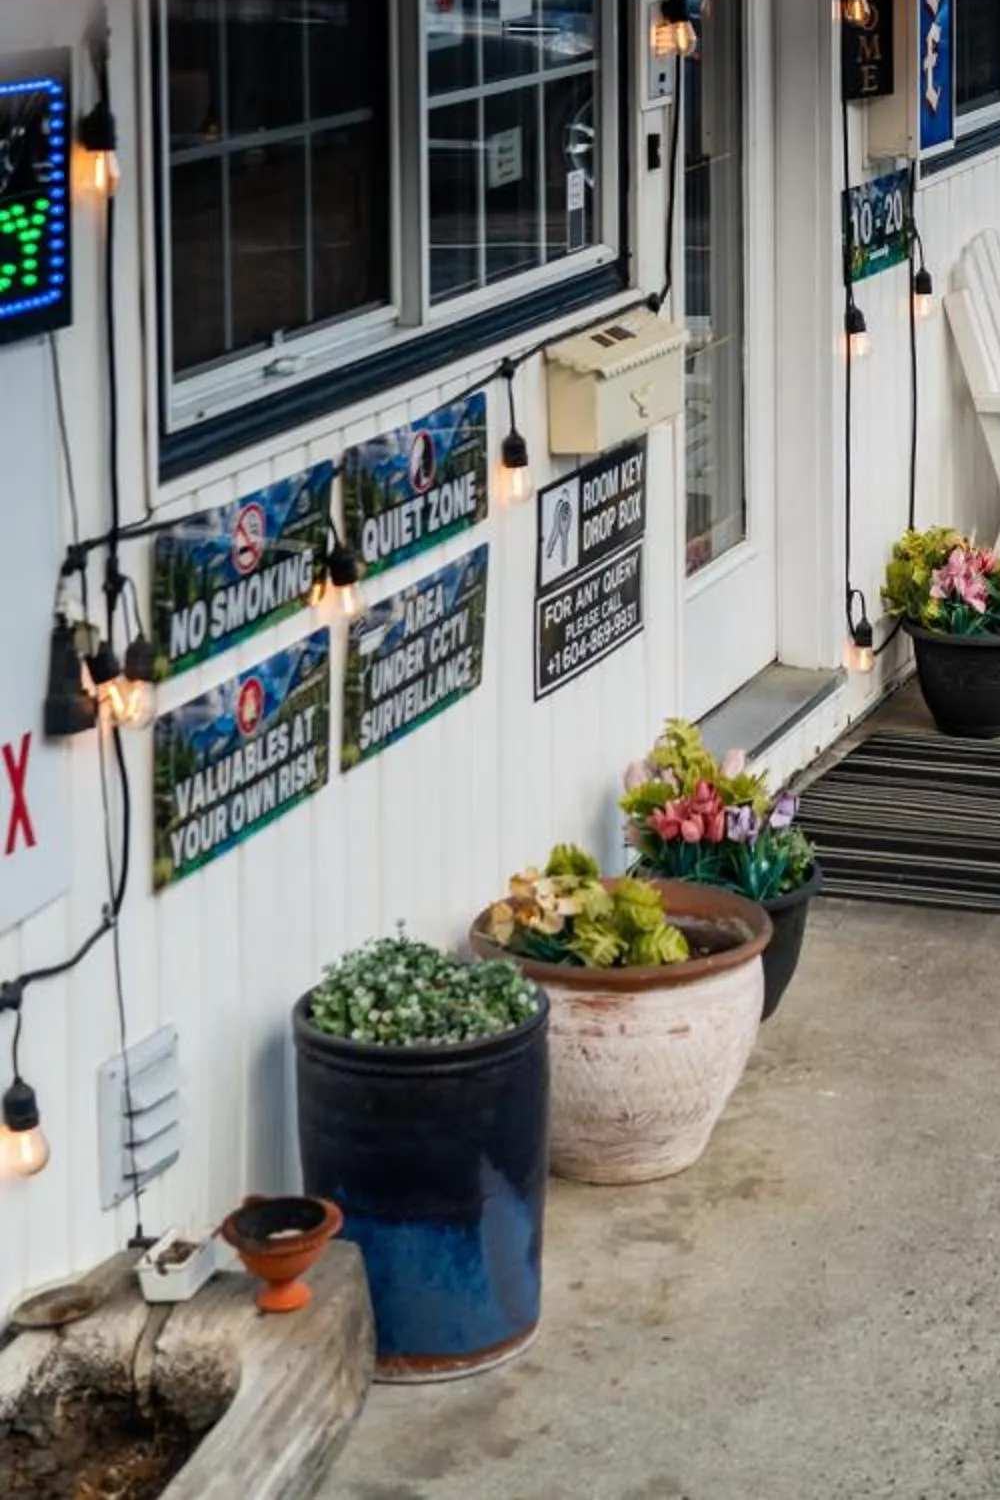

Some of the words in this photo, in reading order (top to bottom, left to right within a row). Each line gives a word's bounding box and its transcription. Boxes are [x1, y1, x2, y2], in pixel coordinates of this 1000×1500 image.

[362, 496, 426, 564] QUIET
[428, 471, 476, 532] ZONE
[583, 470, 618, 512] ROOM
[621, 452, 644, 491] KEY
[583, 506, 617, 550] DROP
[618, 493, 642, 530] BOX
[169, 600, 207, 660] NO
[210, 549, 314, 639] SMOKING
[404, 583, 444, 638] AREA
[544, 598, 572, 629] FOR
[575, 578, 602, 612] ANY
[602, 552, 640, 593] QUERY
[565, 606, 601, 641] PLEASE
[601, 591, 623, 616] CALL
[359, 646, 473, 750] SURVEILLANCE
[371, 637, 425, 700] UNDER
[429, 608, 469, 663] CCTV
[170, 813, 228, 868] YOUR
[231, 779, 276, 833] OWN
[278, 746, 317, 803] RISK
[175, 723, 289, 819] VALUABLES
[291, 705, 315, 748] AT
